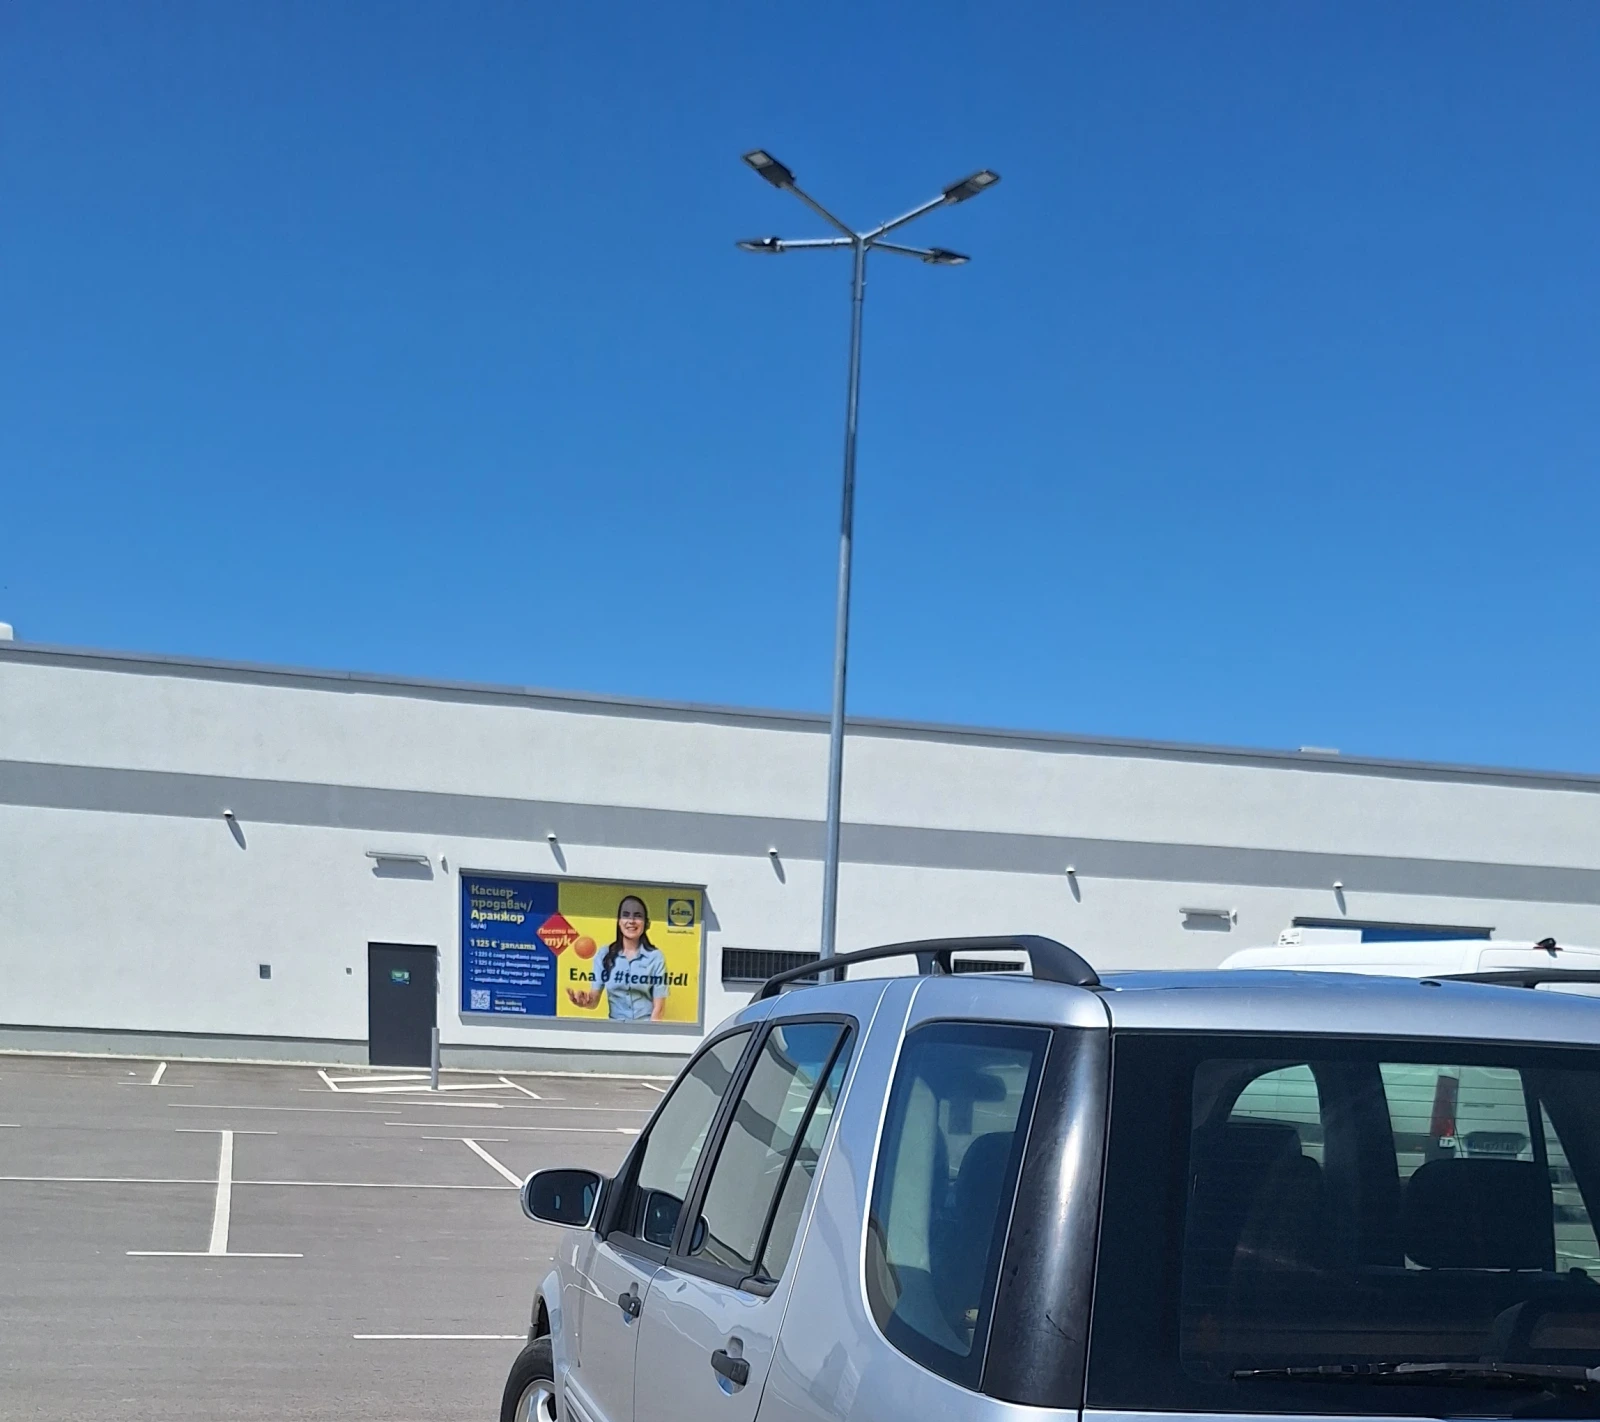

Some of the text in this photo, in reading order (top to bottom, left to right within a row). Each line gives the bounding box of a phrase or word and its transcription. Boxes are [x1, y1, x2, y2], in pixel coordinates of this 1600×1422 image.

[471, 884, 519, 899] Касиер-
[470, 899, 533, 913] продавач/
[470, 909, 525, 925] Аранжор
[476, 939, 490, 948] 125
[500, 942, 536, 951] заплата
[544, 935, 571, 949] тук
[570, 968, 597, 982] Ела
[614, 970, 689, 987] #teamlidl
